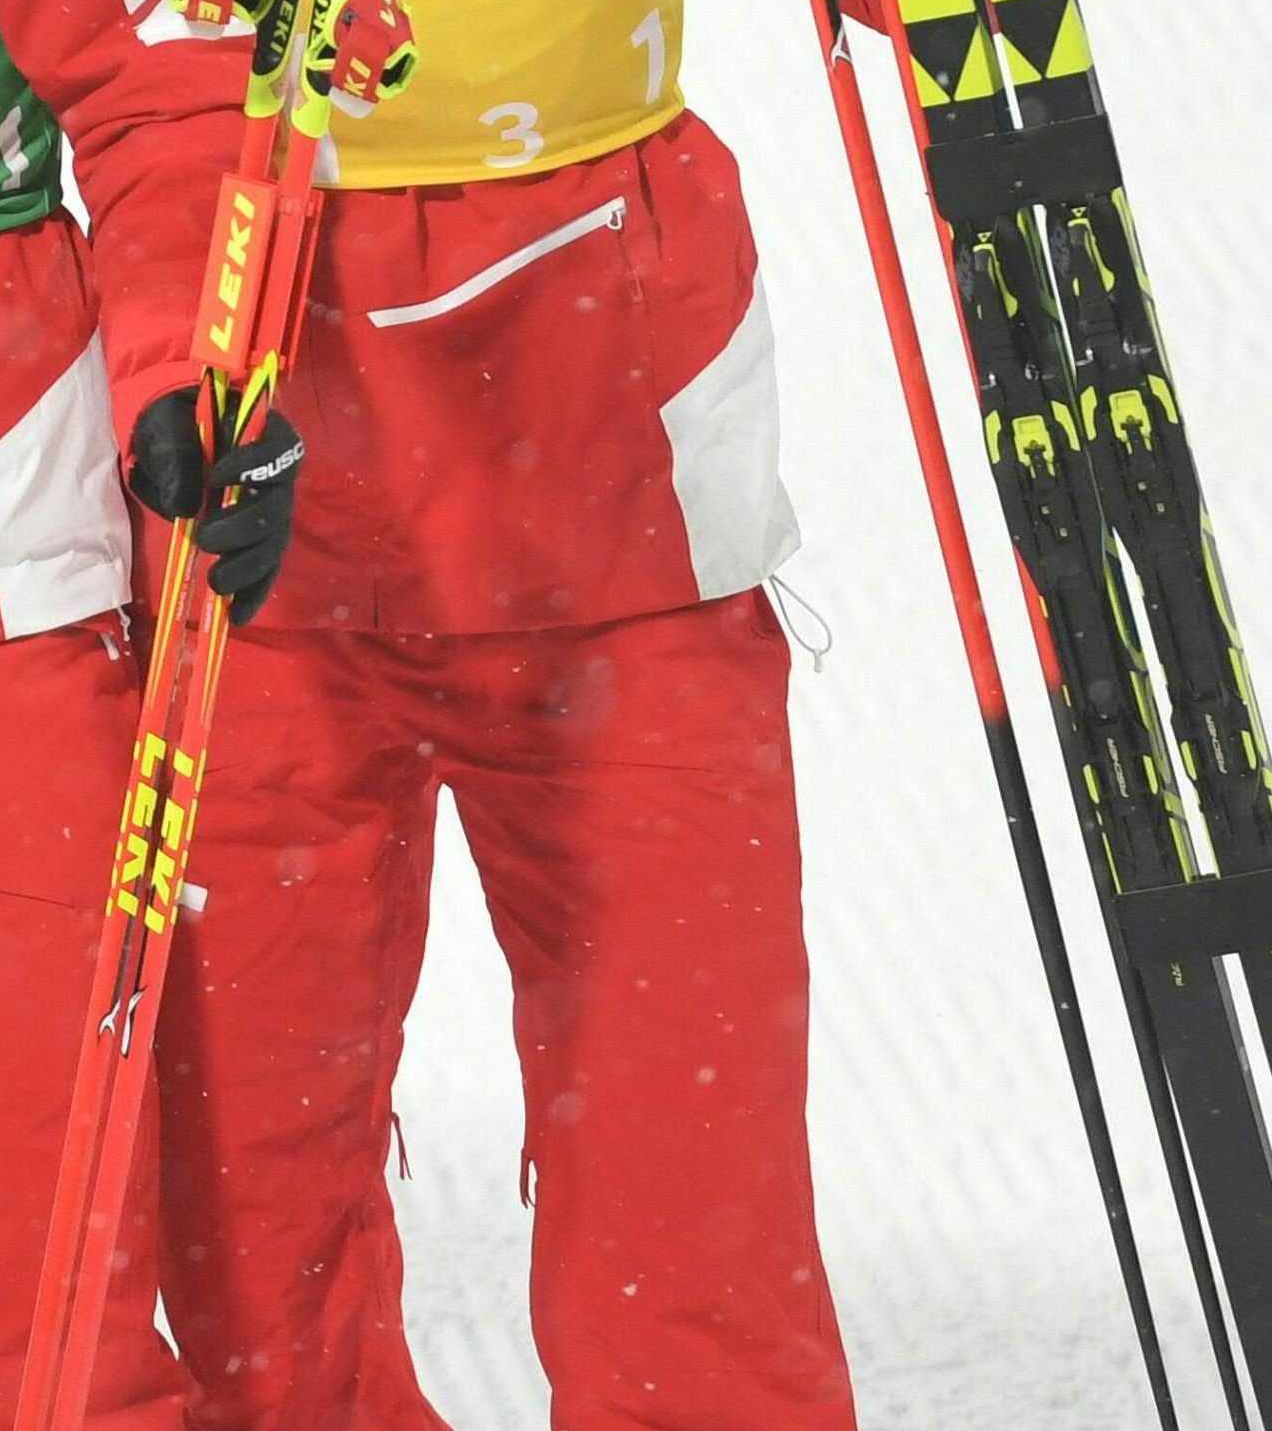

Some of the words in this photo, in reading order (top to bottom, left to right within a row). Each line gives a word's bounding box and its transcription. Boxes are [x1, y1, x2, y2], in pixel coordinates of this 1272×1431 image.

[630, 7, 666, 106] 1
[478, 102, 545, 168] 3
[209, 191, 255, 353] LEKI
